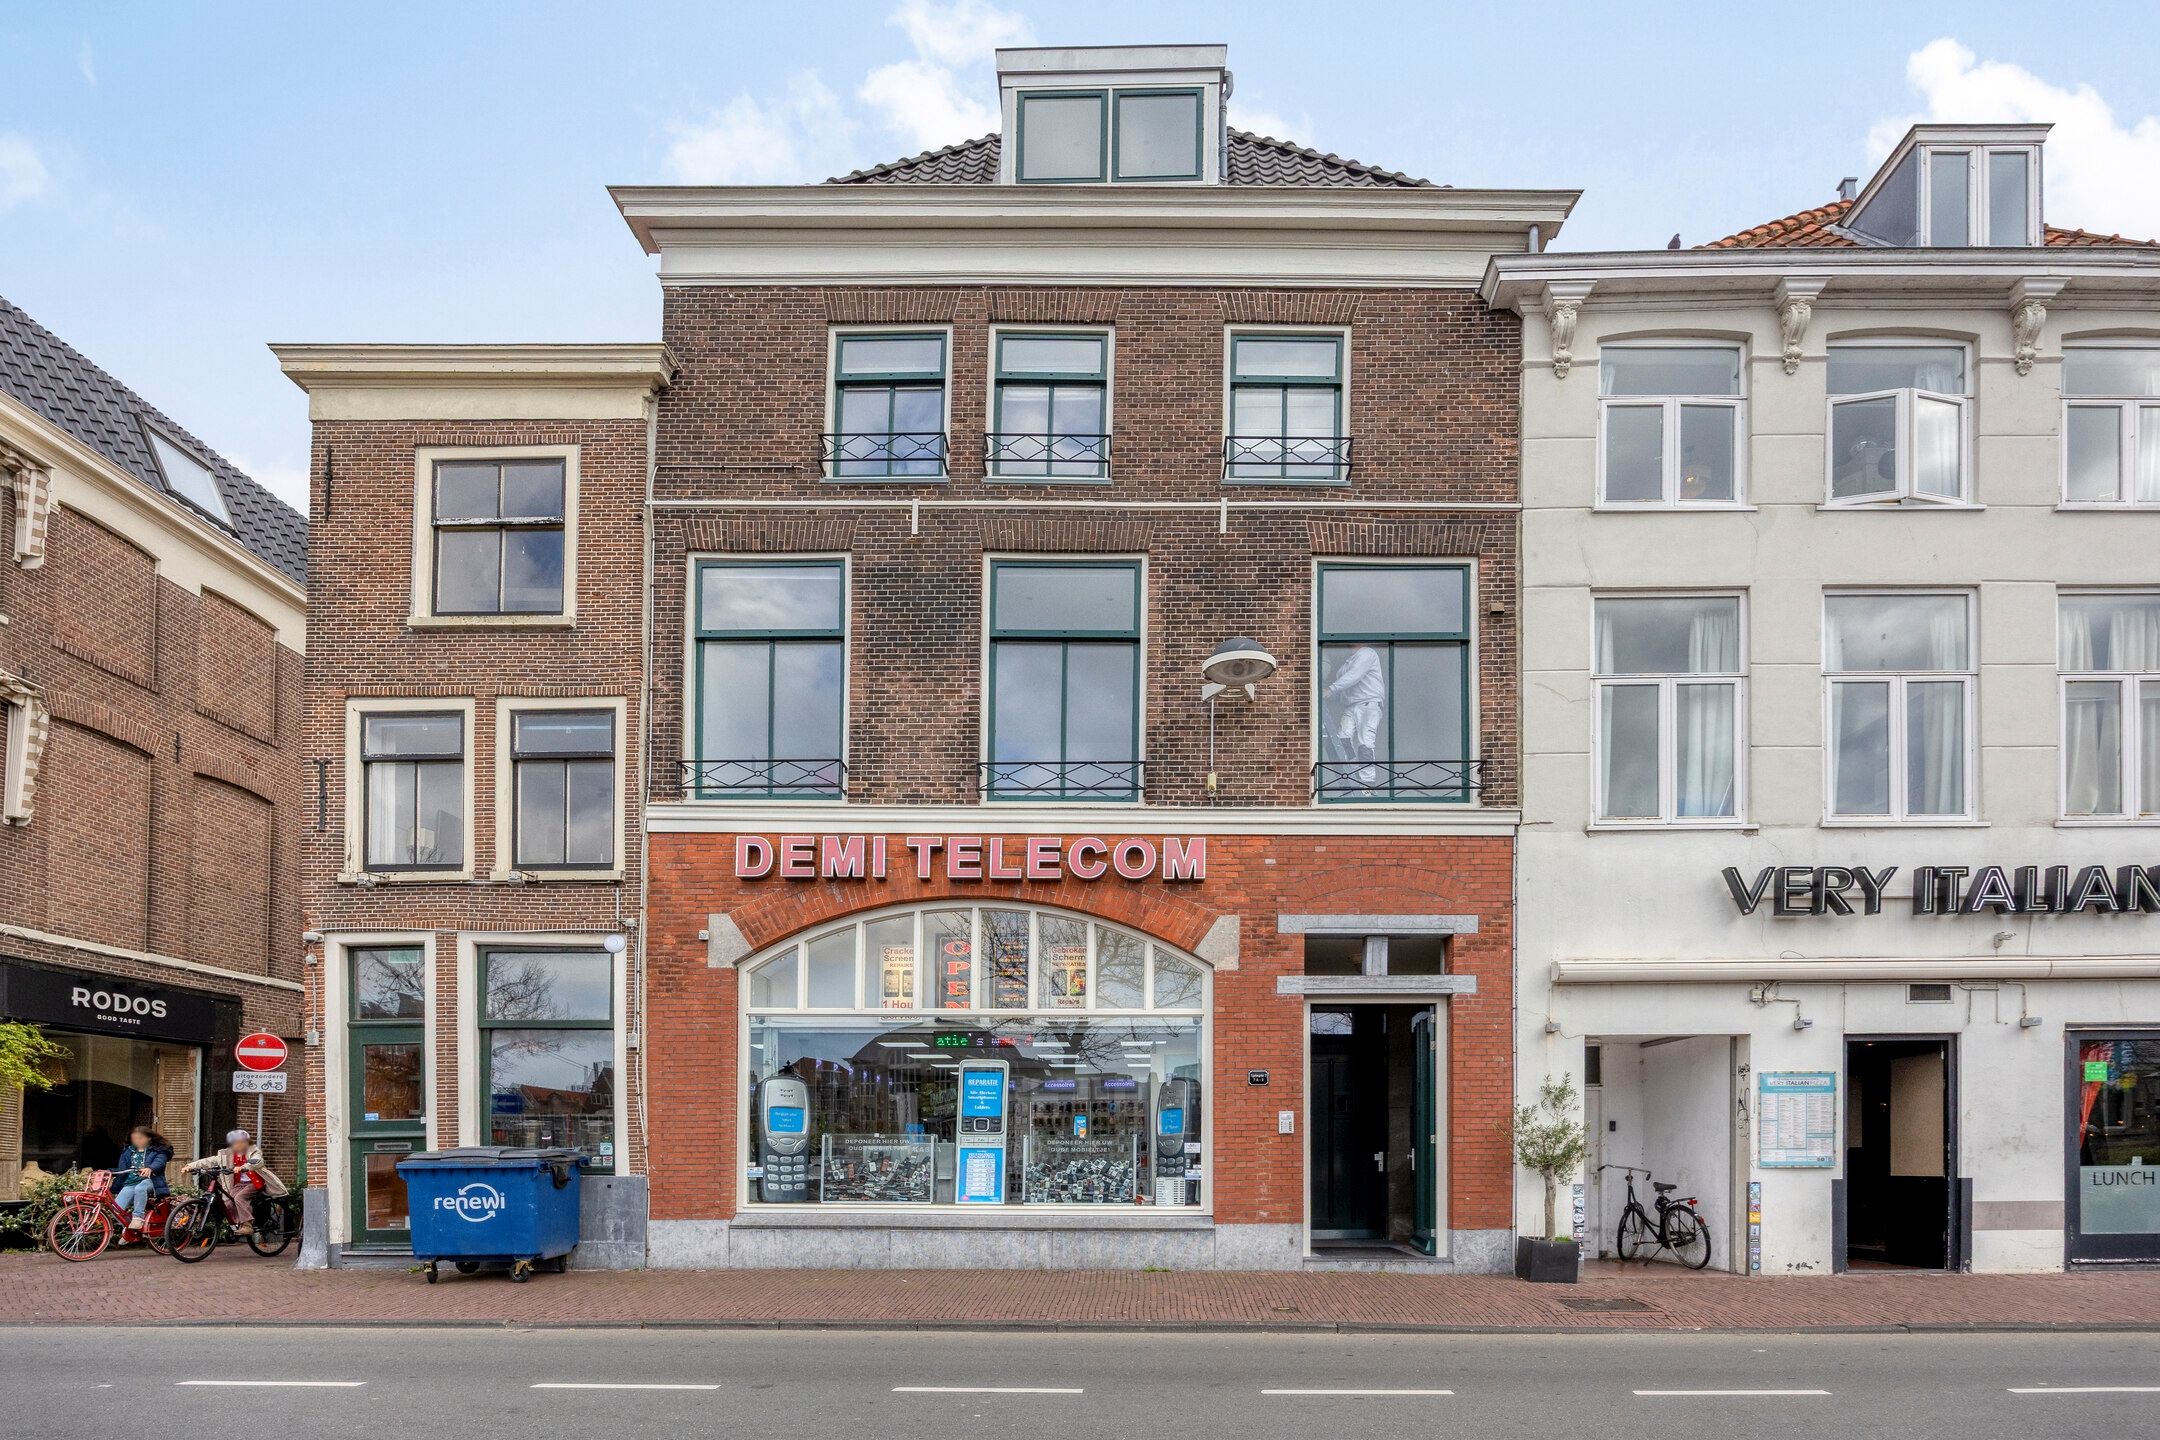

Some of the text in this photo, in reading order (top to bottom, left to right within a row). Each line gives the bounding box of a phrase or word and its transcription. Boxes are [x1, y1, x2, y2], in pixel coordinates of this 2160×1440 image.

[735, 835, 1207, 882] DEMI TELECOM
[1722, 865, 2160, 916] VERY ITALIAN
[883, 947, 914, 955] Cracke
[71, 986, 168, 1019] RODOS
[891, 1000, 914, 1009] Hou
[96, 1014, 141, 1026] GOOD TASTE
[1044, 1080, 1076, 1089] Accessoires
[1103, 1080, 1136, 1088] Accessoires
[2093, 1171, 2155, 1186] LUNCH
[433, 1191, 506, 1211] renewi
